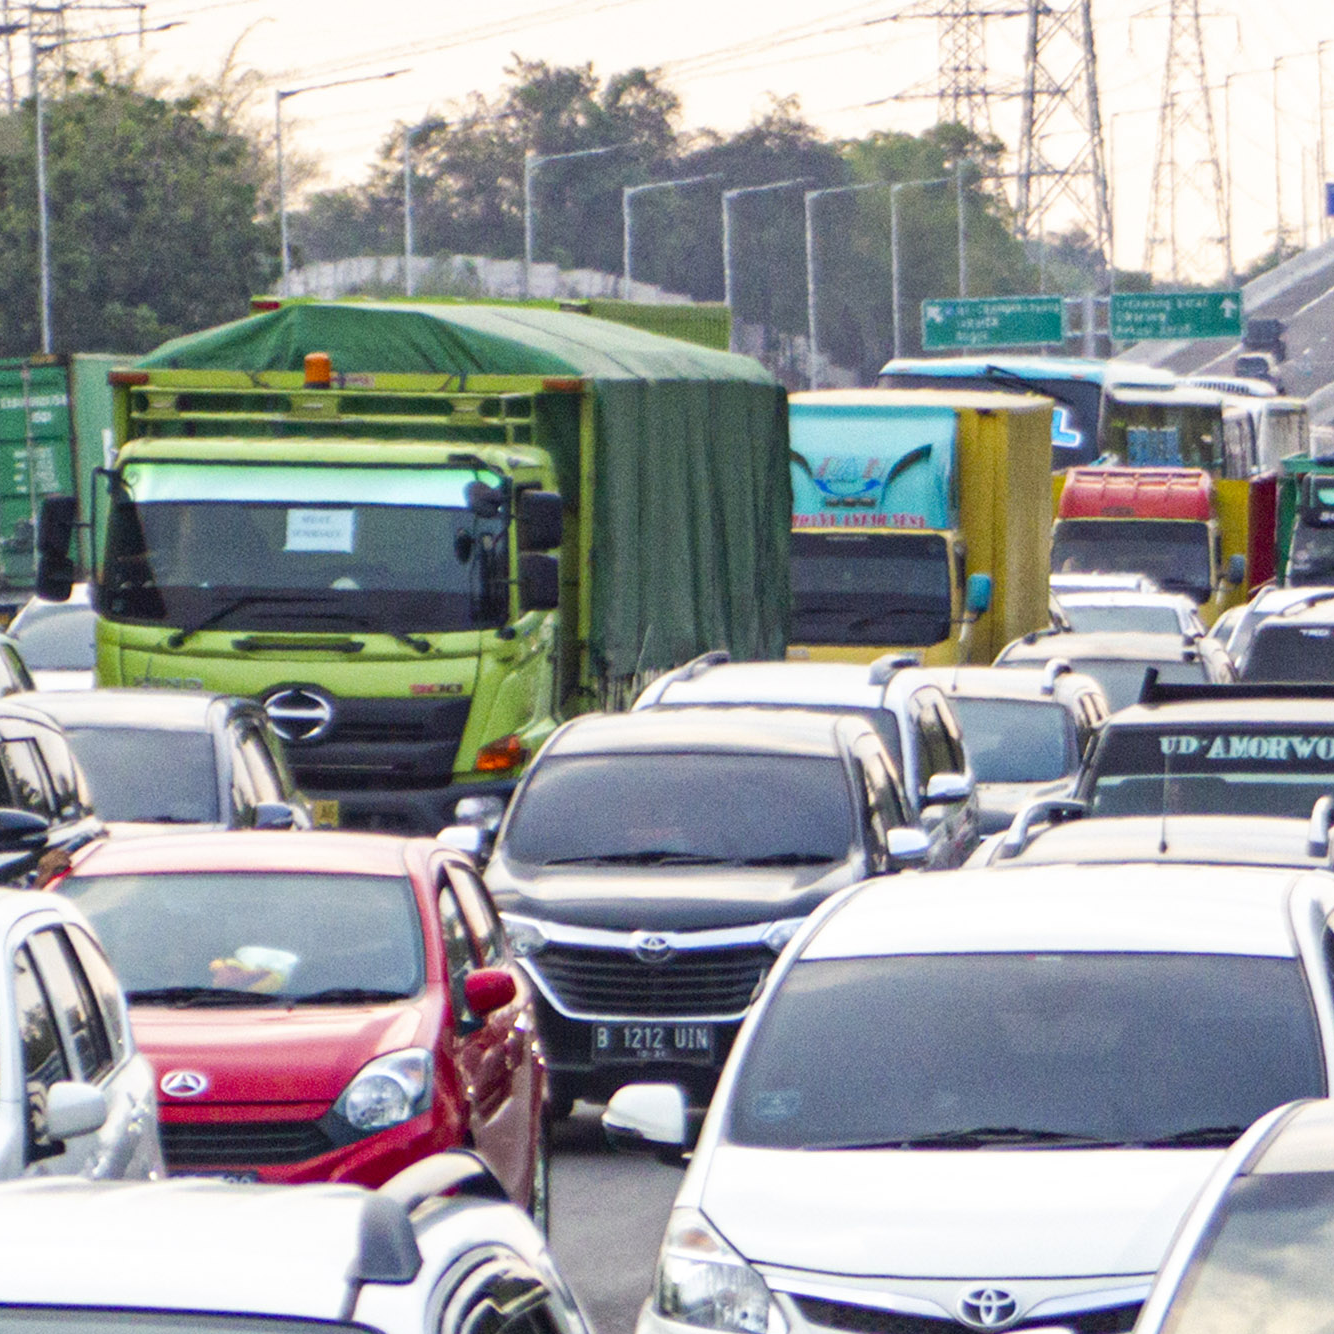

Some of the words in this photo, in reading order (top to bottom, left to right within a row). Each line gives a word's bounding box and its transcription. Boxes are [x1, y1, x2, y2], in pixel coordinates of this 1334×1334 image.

[597, 1027, 610, 1048] B
[624, 1027, 663, 1048] 1212
[675, 1026, 708, 1048] UIN
